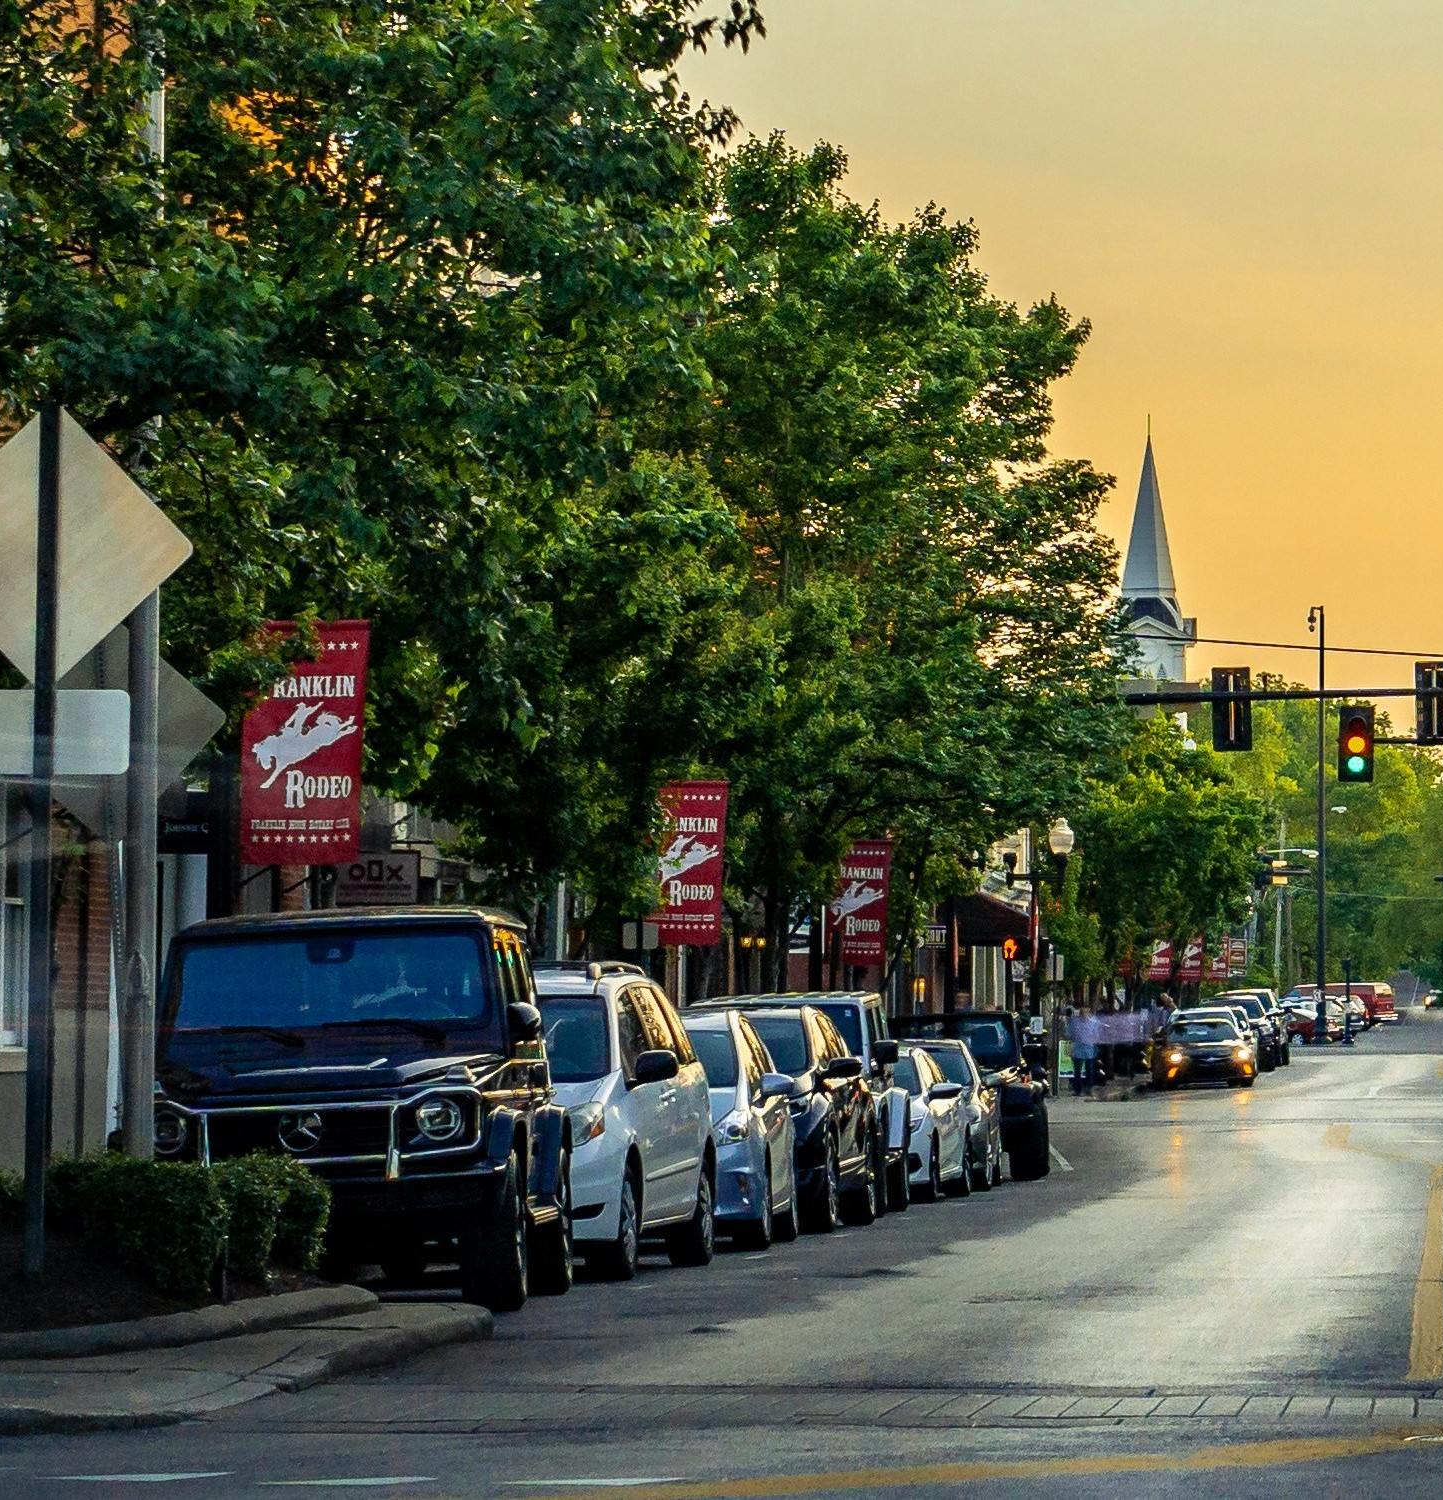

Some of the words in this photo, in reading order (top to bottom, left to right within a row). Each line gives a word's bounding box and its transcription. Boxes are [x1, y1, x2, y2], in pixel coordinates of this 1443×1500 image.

[273, 675, 356, 698] RANKLIN
[284, 769, 352, 808] RODEO
[840, 866, 883, 880] RANKLIN
[669, 880, 714, 907] RODEO
[846, 916, 881, 936] RODEO
